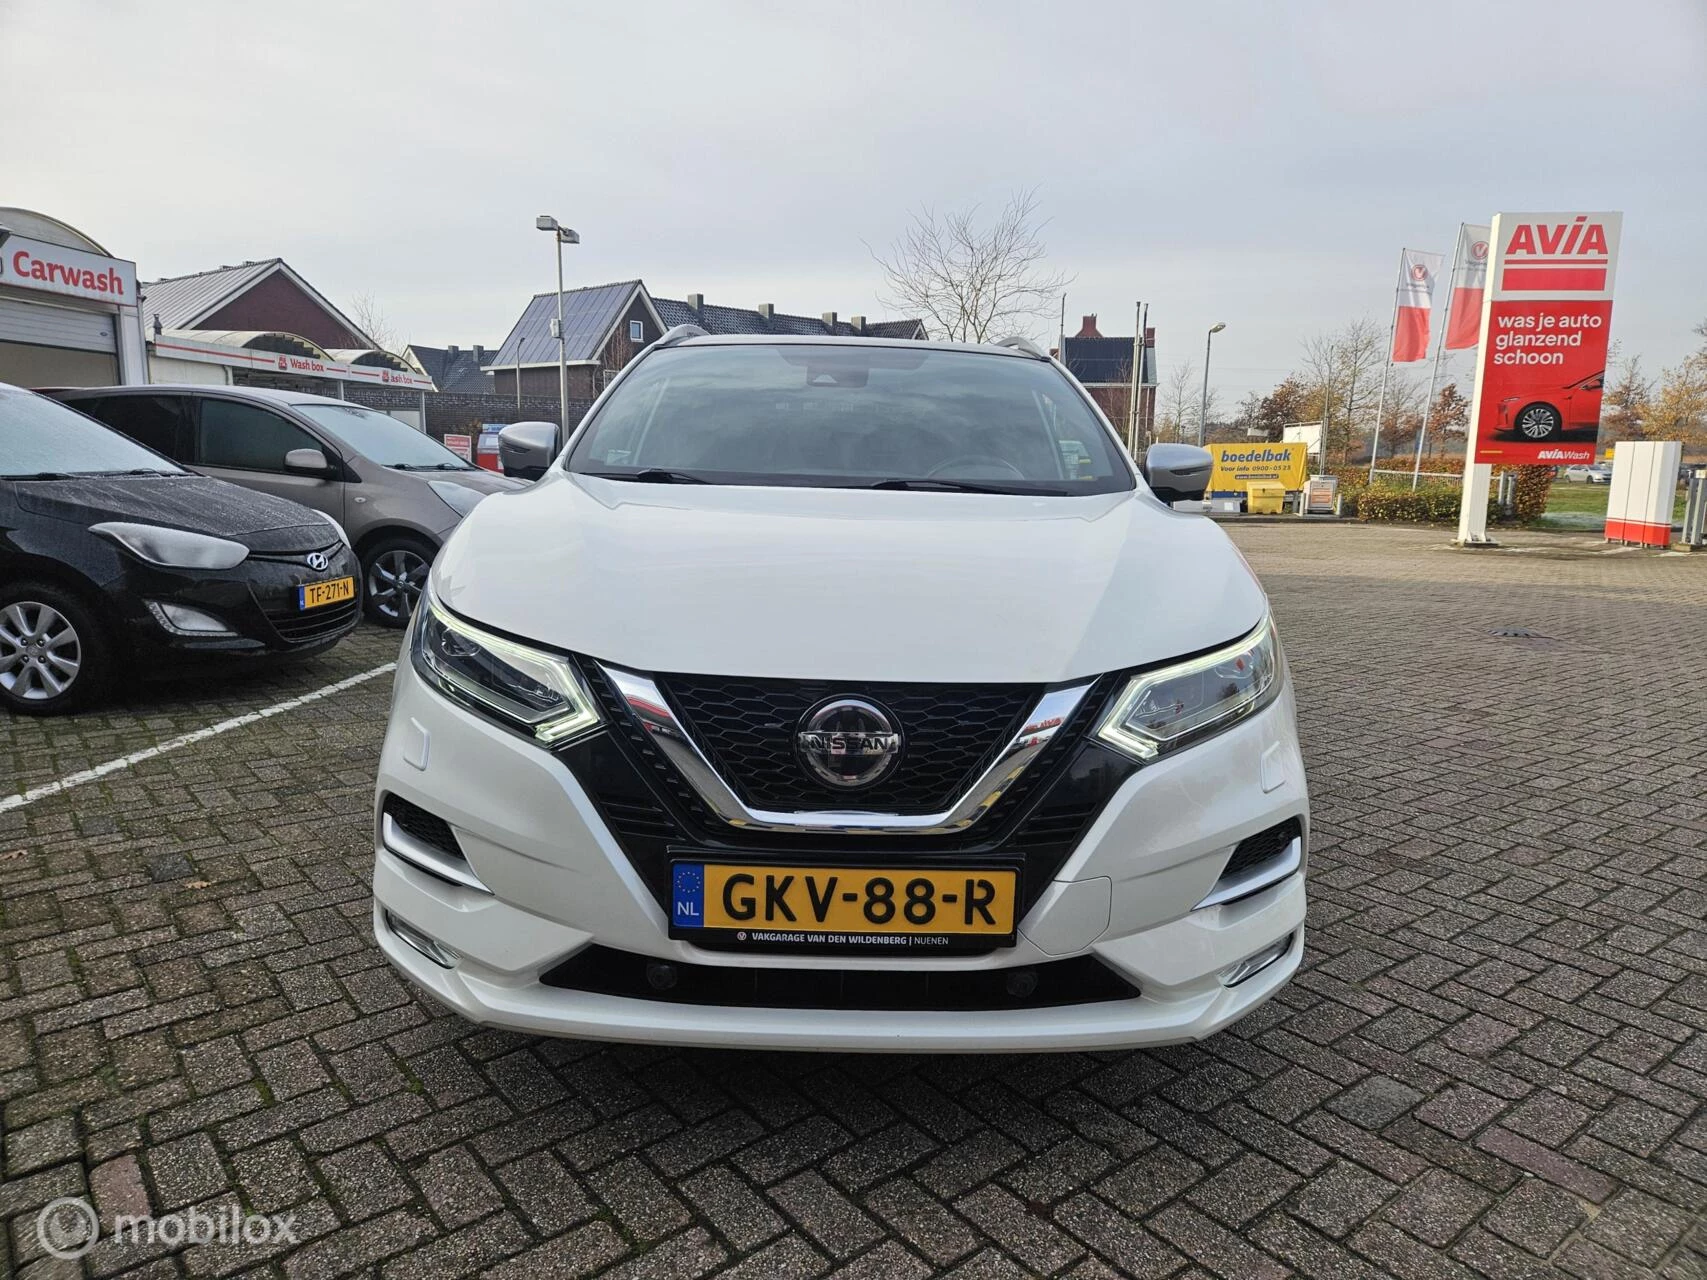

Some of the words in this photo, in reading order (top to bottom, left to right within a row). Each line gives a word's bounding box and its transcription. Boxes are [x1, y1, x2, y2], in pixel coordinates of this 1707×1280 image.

[12, 251, 124, 295] Carwash
[1498, 316, 1535, 328] was
[1536, 313, 1555, 331] je
[1559, 313, 1602, 328] auto
[1495, 330, 1583, 350] glanzend
[290, 358, 310, 370] Wash
[311, 360, 324, 372] box
[1493, 350, 1564, 365] schoon
[1221, 449, 1291, 463] boedelbak
[310, 580, 349, 604] TF-271-N
[808, 735, 889, 752] NISSAN
[722, 872, 996, 926] GKV-88-R
[677, 901, 700, 917] NL
[751, 932, 805, 942] VAKGARAGE
[807, 934, 826, 943] VAN
[828, 934, 846, 943] DEN
[848, 935, 907, 945] WILDENBERG
[914, 936, 949, 945] NUENEN
